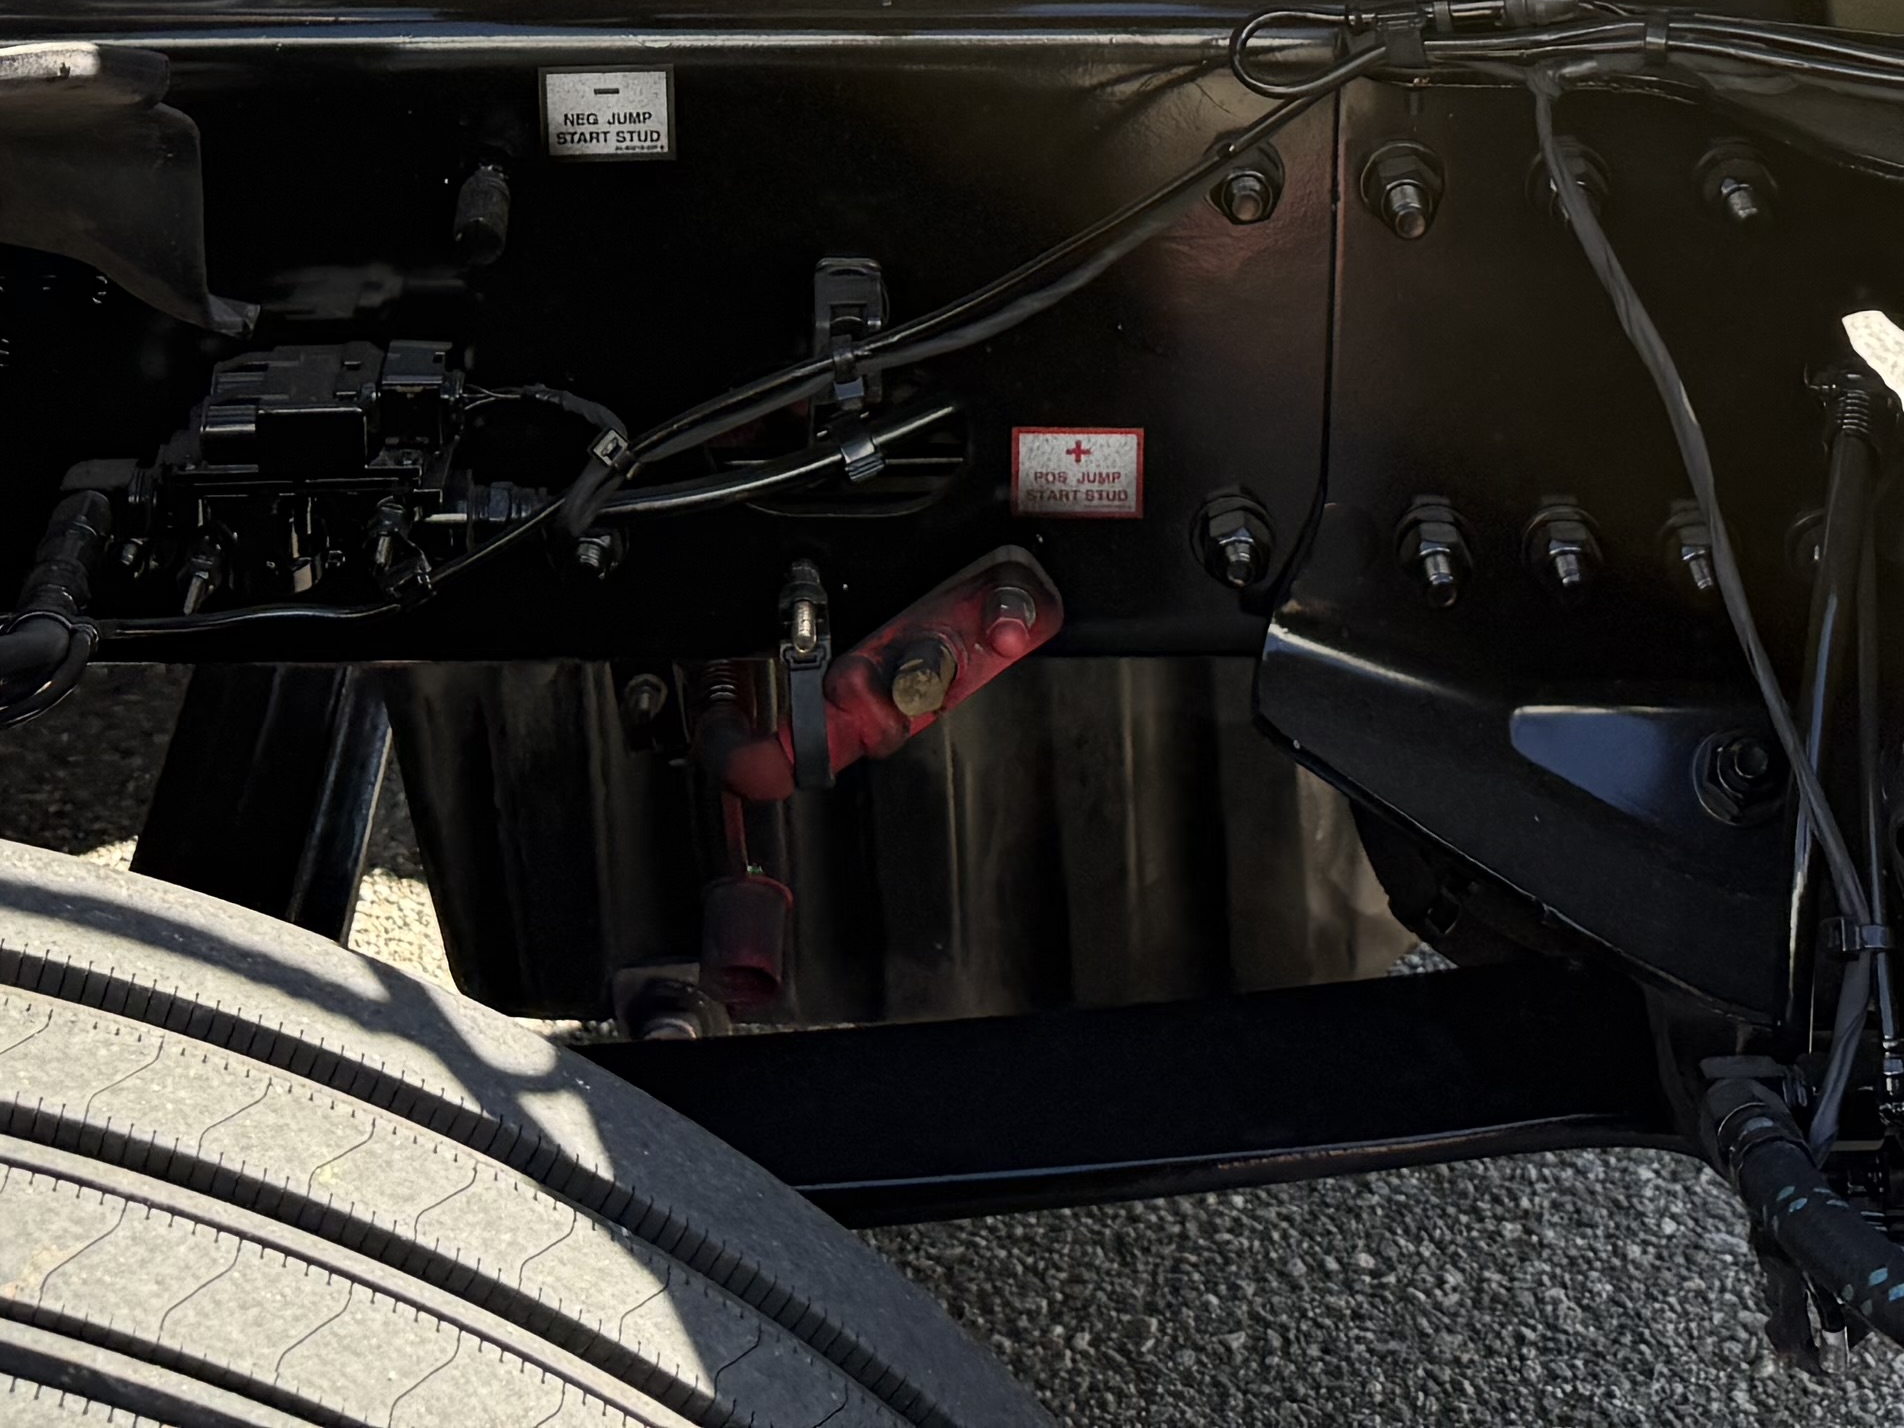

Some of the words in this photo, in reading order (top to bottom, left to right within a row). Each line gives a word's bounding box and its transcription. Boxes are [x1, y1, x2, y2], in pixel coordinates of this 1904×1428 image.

[563, 112, 599, 126] NEG
[606, 111, 653, 126] JUMP
[556, 130, 610, 145] START
[615, 130, 661, 144] STUD
[1034, 471, 1068, 484] POS
[1077, 471, 1122, 484] JUMP
[1026, 488, 1081, 503] START
[1084, 489, 1129, 503] STUD
